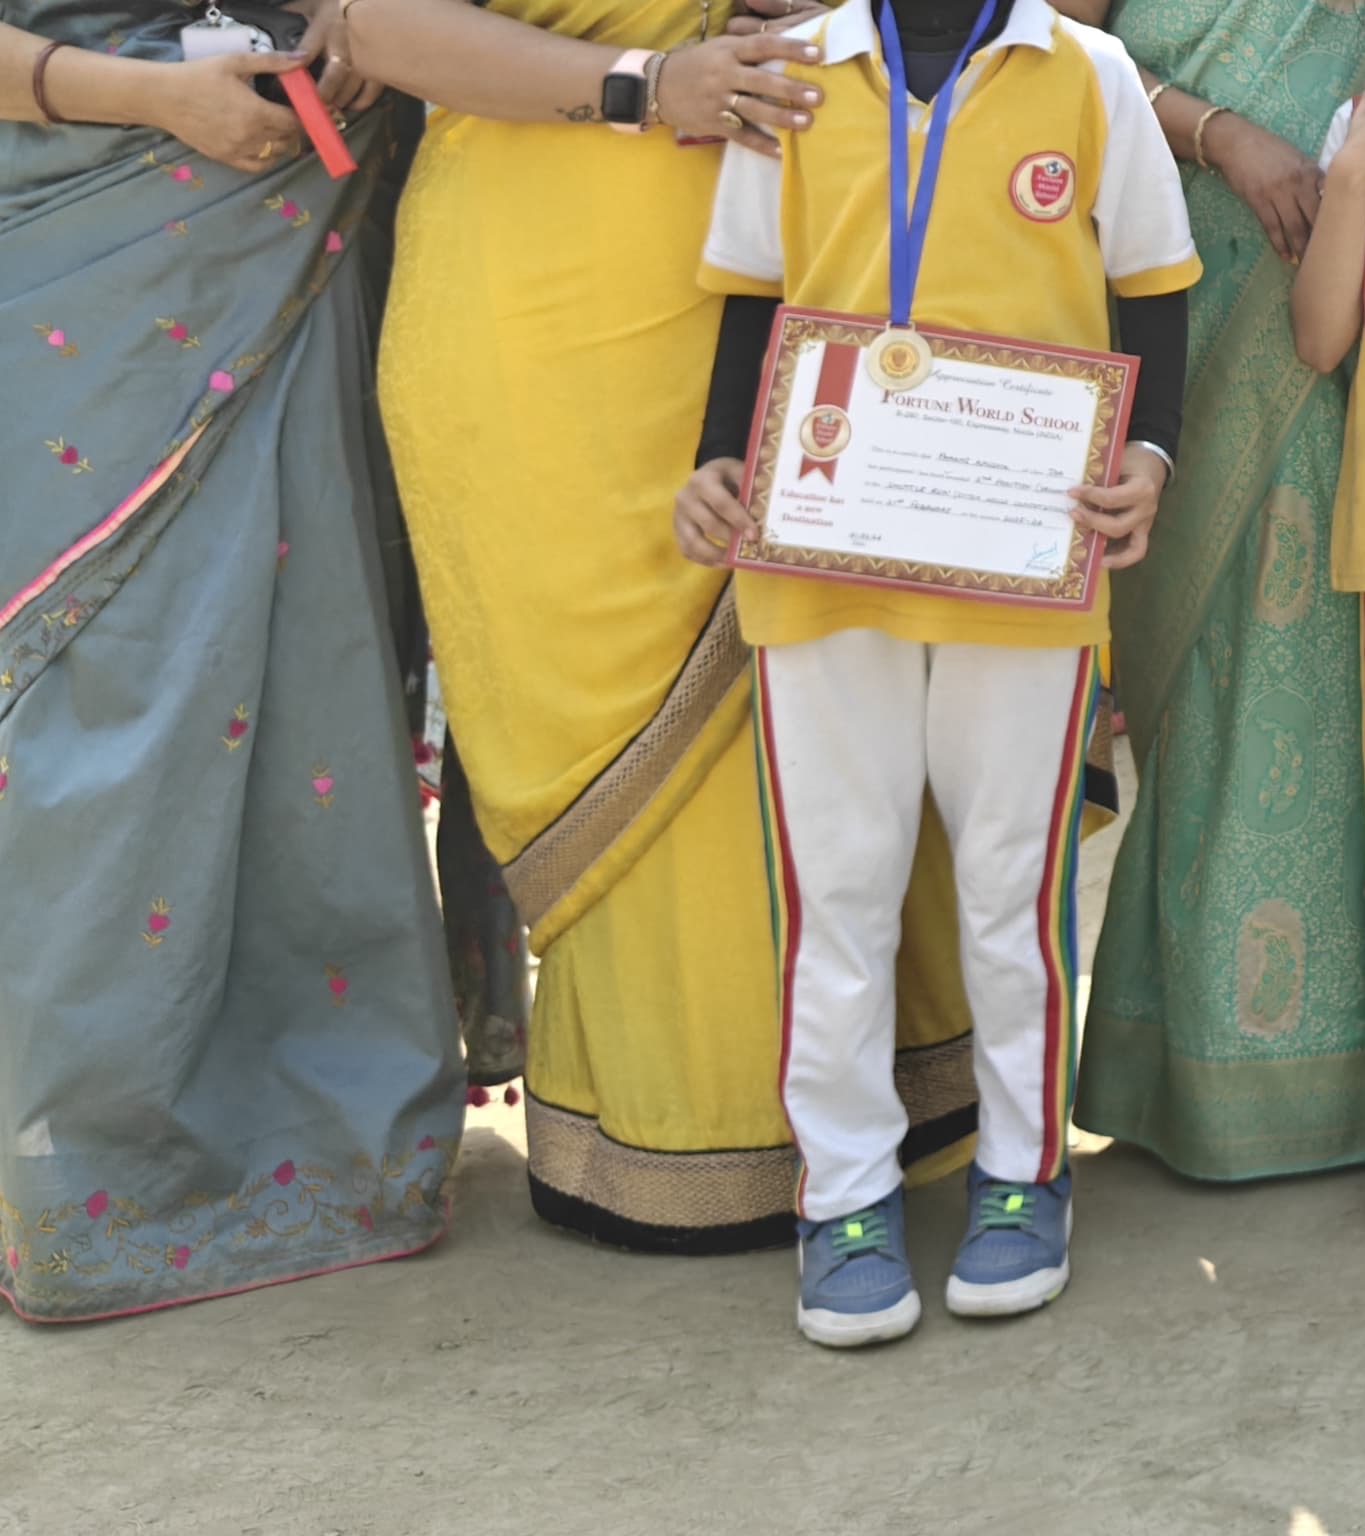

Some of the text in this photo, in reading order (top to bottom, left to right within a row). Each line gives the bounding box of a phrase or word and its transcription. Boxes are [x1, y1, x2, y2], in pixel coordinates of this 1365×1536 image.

[880, 389, 1082, 433] FORTUNE WORLD SCHOOL
